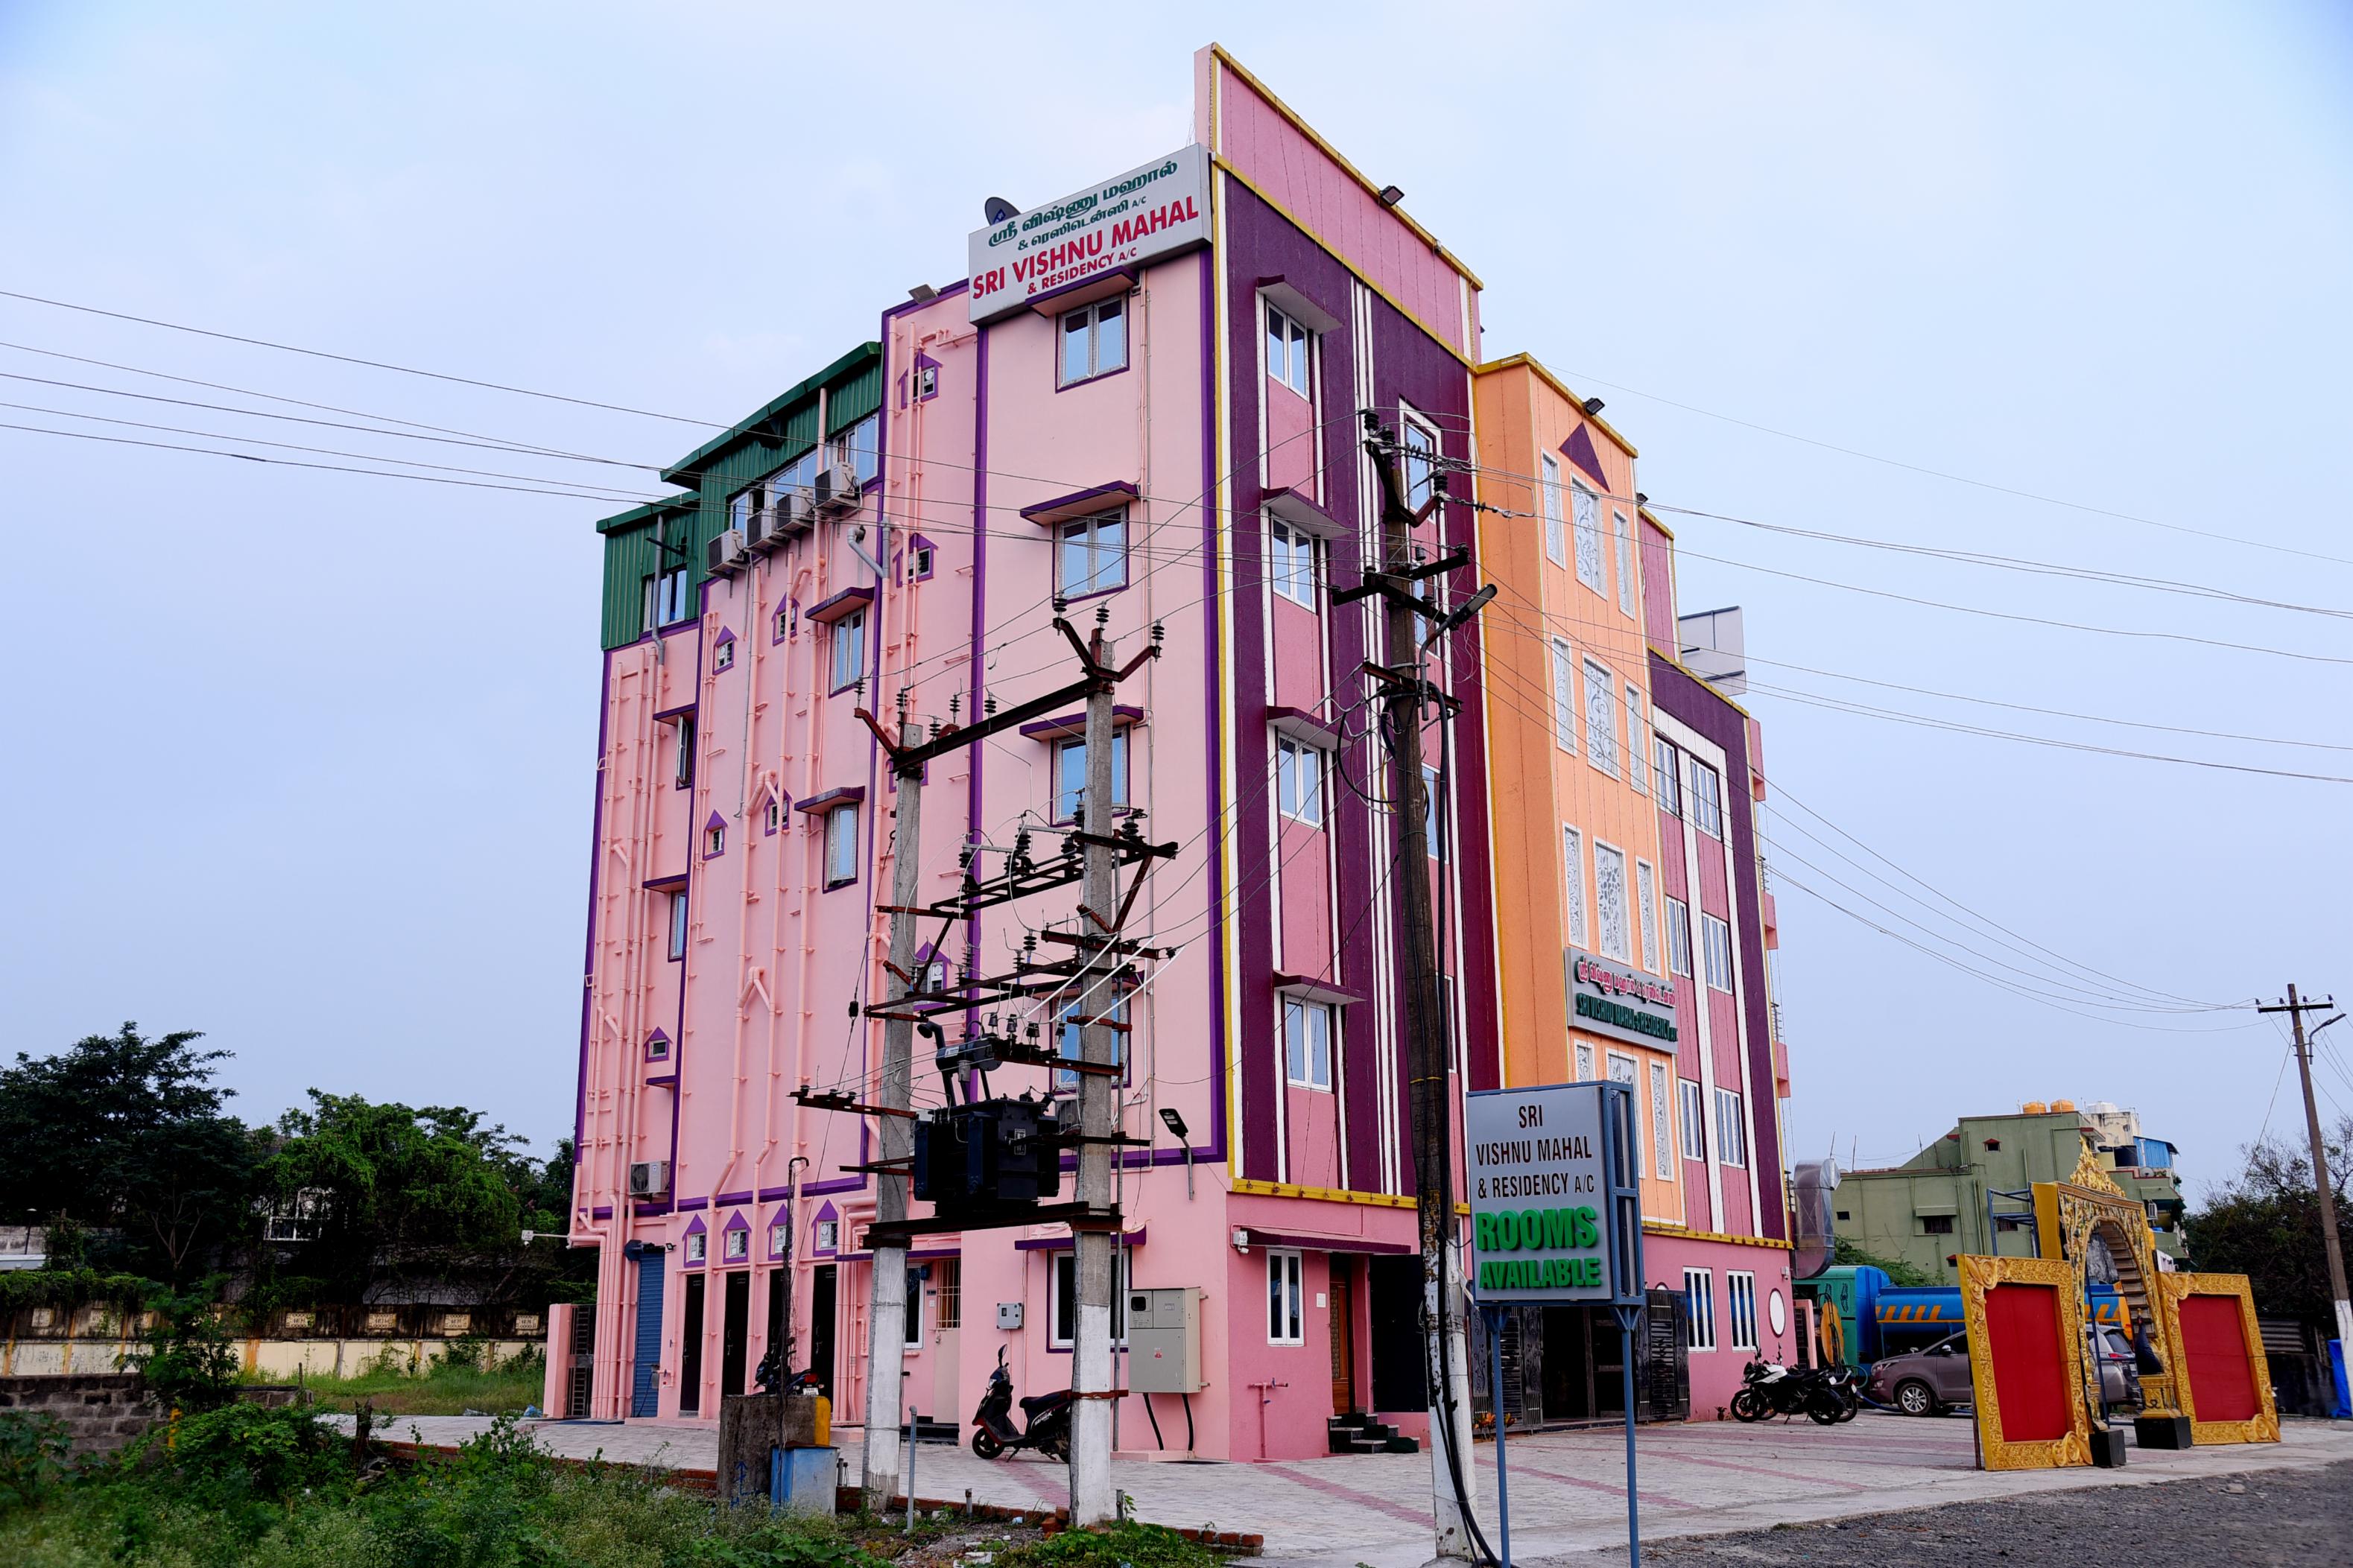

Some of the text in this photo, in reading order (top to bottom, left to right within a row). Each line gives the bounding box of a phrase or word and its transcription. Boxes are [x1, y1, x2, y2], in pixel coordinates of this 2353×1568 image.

[1022, 193, 1098, 232] விஷ்ணு
[1103, 160, 1178, 200] மஹால்
[1018, 196, 1147, 251] & ரெஸிடென்ஸி A/C
[973, 196, 1199, 299] SRI VISHNU MAHAL
[1027, 247, 1137, 295] & RESIDENCY A/C
[1577, 992, 1589, 1015] SRI
[1590, 995, 1613, 1023] VISHNU
[1613, 1003, 1635, 1029] MAHAL
[1639, 1012, 1670, 1040] RESIDENCY
[1518, 1104, 1544, 1129] SRI
[1475, 1135, 1592, 1167] VISHNU MAHAL
[1478, 1172, 1594, 1199] & RESIDENCY A/C
[1475, 1205, 1598, 1251] ROOMS
[1479, 1257, 1602, 1289] AVAILABLE
